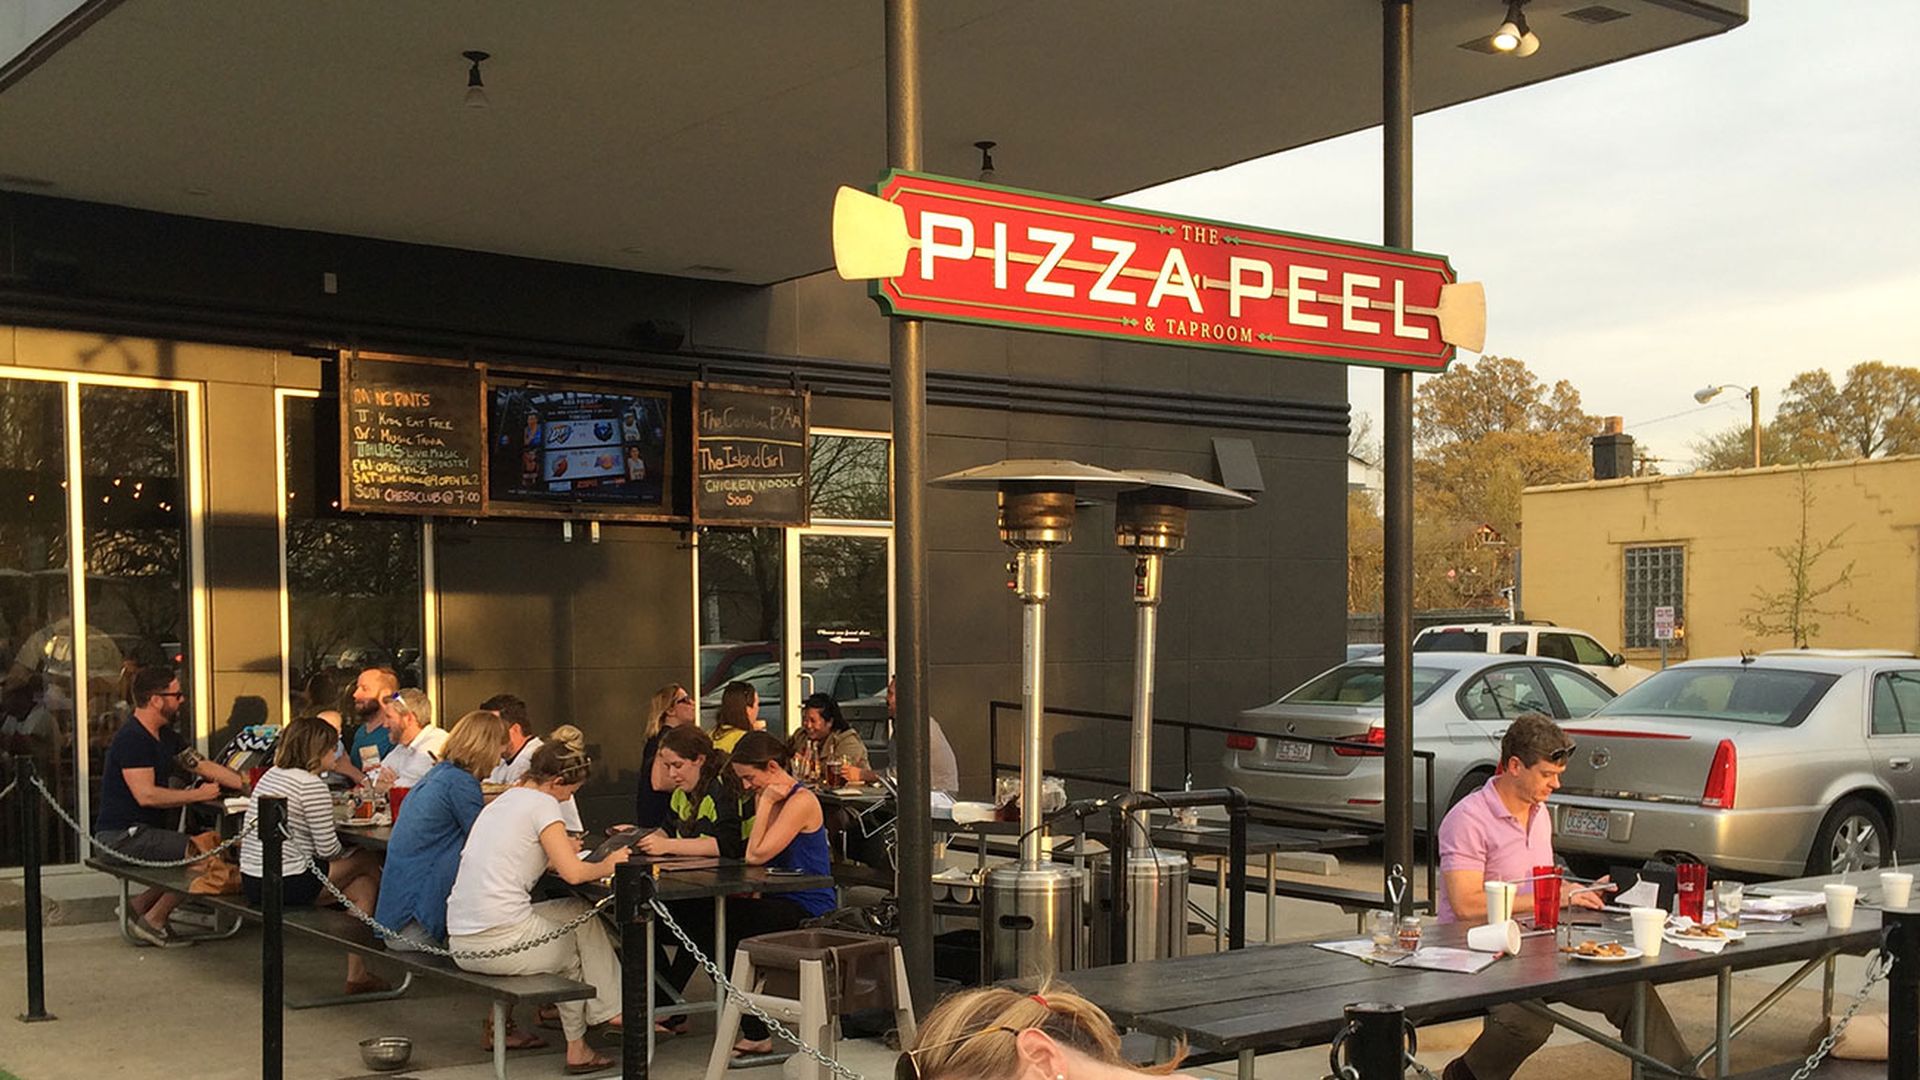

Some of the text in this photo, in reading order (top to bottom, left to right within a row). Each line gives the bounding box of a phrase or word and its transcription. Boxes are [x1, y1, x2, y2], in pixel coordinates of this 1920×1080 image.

[1182, 224, 1219, 245] THE
[920, 211, 1430, 339] PIZZA PEEL
[1144, 317, 1254, 342] & TAPROOM
[394, 392, 431, 407] PINTS
[698, 444, 785, 471] The Island Girl
[419, 466, 428, 475] 2
[704, 477, 804, 493] CHICKEN NOODLE
[454, 490, 481, 504] 7:00
